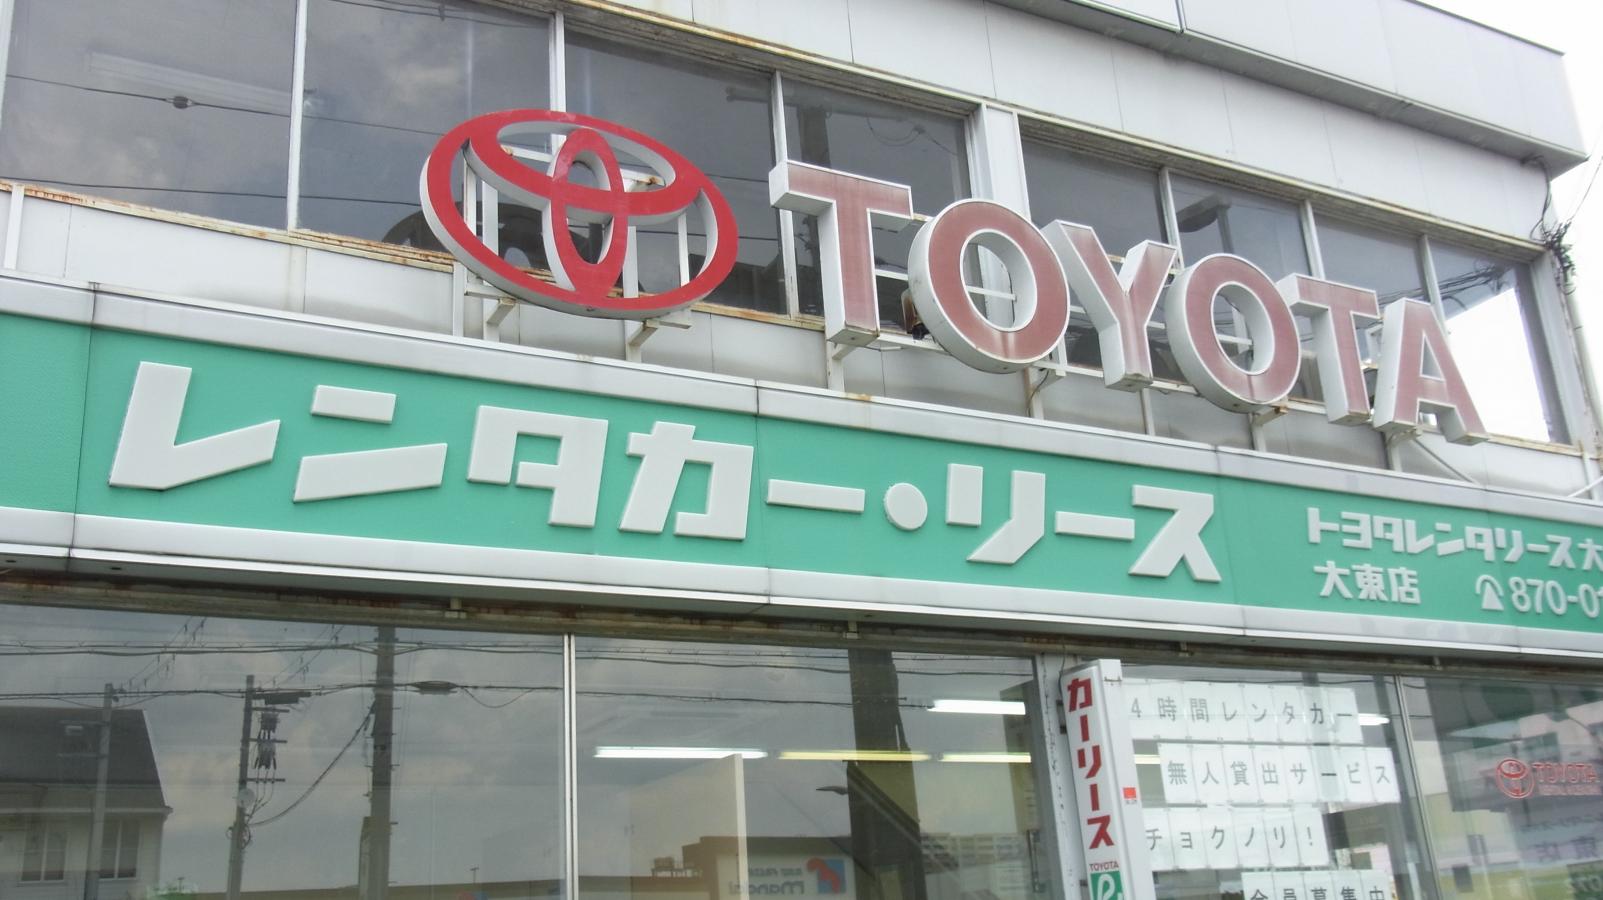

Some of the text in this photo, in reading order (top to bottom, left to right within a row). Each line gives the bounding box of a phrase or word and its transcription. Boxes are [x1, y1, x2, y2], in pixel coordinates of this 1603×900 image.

[769, 160, 1486, 445] TOYOTA
[109, 361, 1222, 583] レンタカー・リース
[1307, 507, 1603, 571] トヨタレンタリース大
[1313, 560, 1421, 605] 大東店
[1510, 577, 1603, 619] 870-0
[1067, 678, 1115, 850] カーリース
[1167, 760, 1391, 786] 無人貸出サービス
[1089, 861, 1119, 871] TOYOTA
